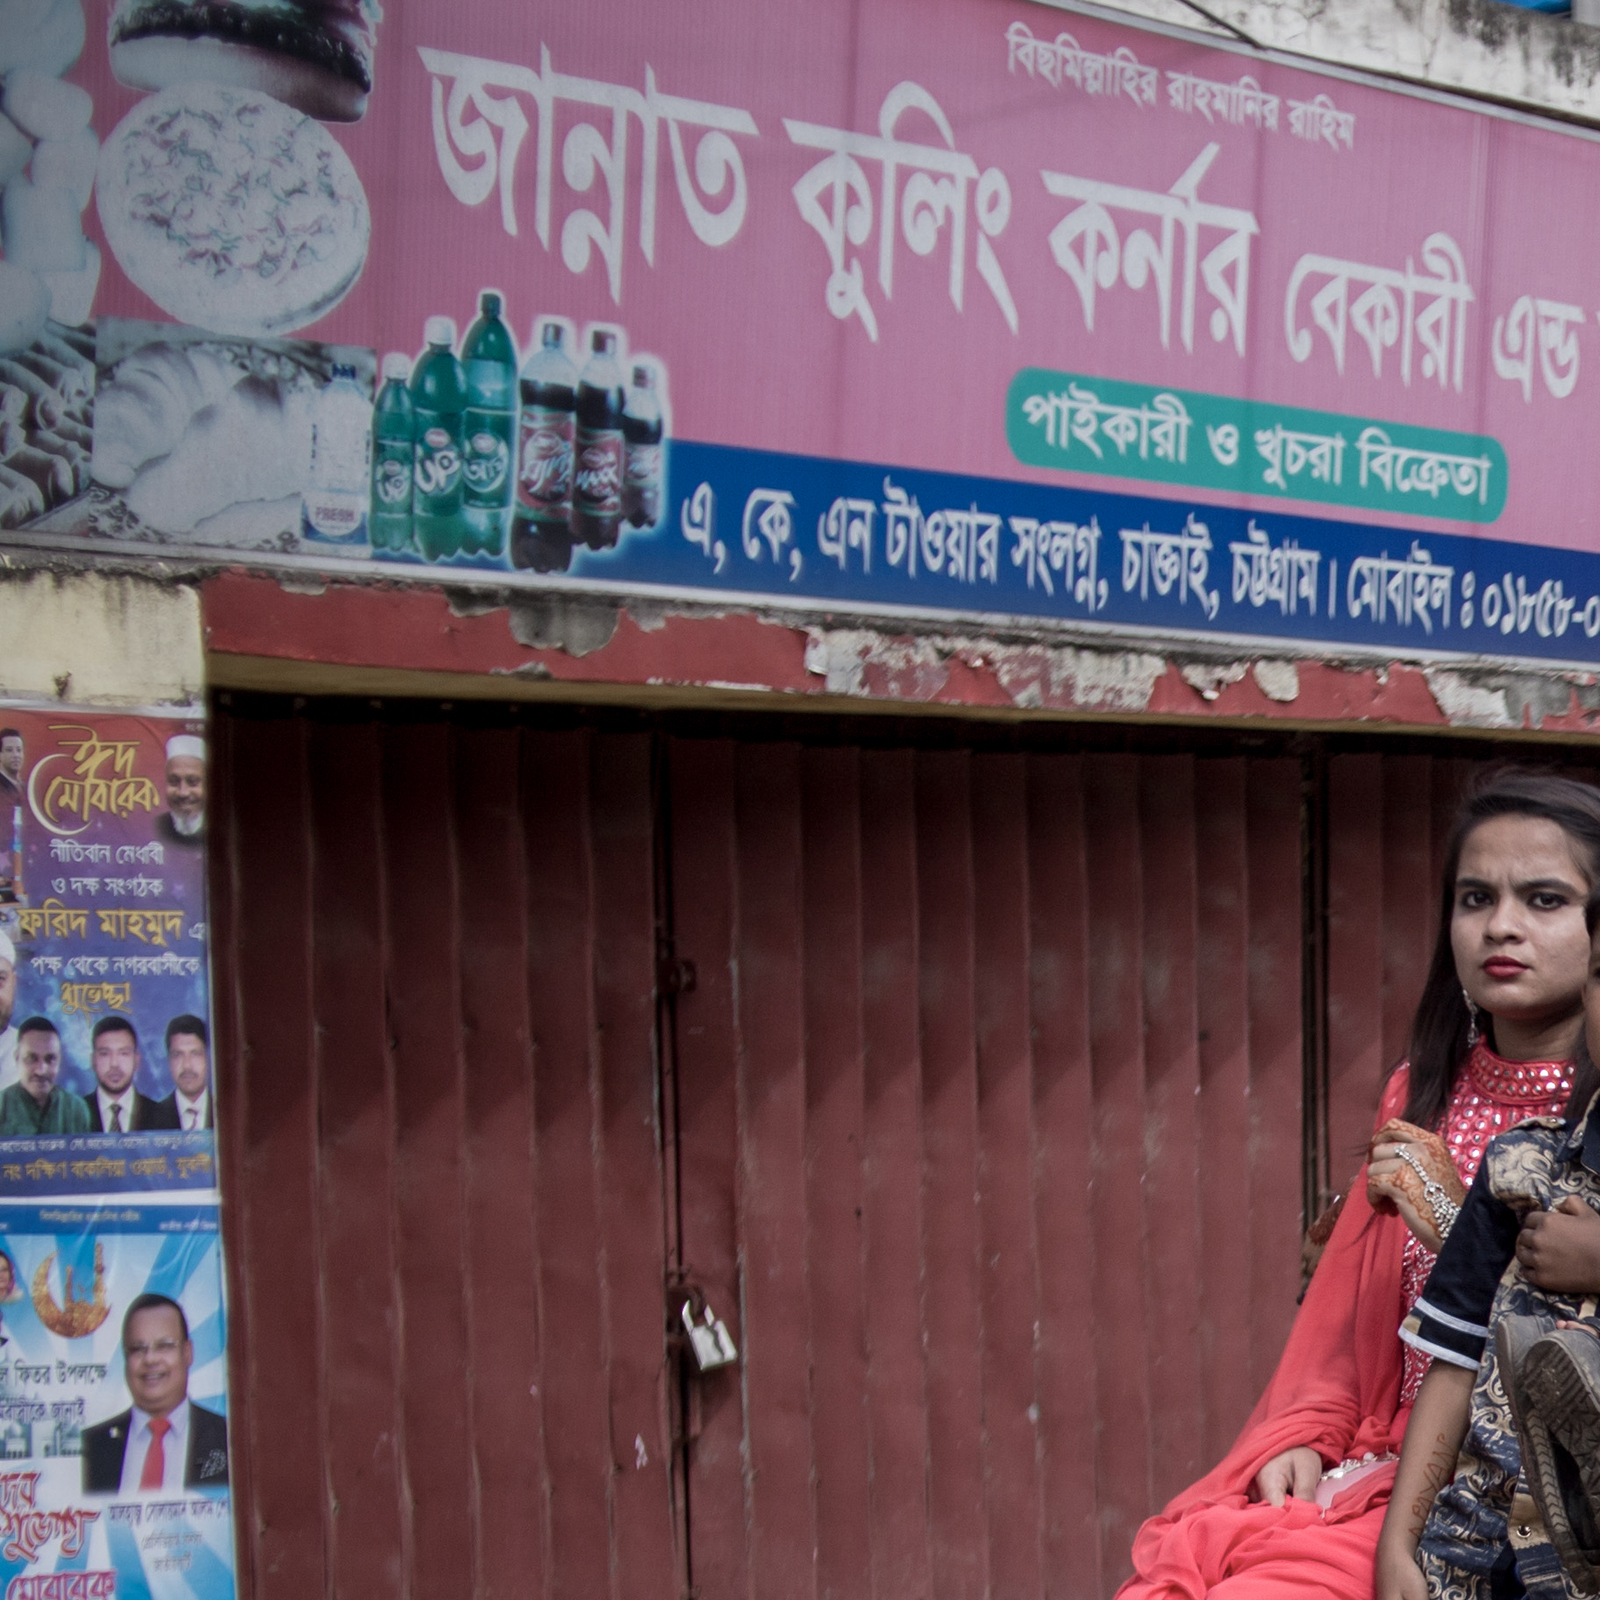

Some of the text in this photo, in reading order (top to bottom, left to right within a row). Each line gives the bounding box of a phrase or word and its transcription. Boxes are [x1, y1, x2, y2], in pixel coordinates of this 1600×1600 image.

[416, 41, 760, 306] জান্নাত
[782, 81, 1019, 343] কুলিং
[1285, 232, 1475, 394] বেকারী
[1023, 383, 1491, 505] পাইকারী ও খুচরা বিক্রেতা
[818, 496, 876, 575] এন
[47, 724, 140, 779] ঈদ
[44, 775, 160, 822] মোবারক
[50, 838, 164, 865] নীতিবান মেধাবী
[51, 873, 164, 897] ও দক্ষ সংগঠক
[16, 898, 89, 938] ফরিদ
[96, 906, 185, 947] মাহমুদ
[31, 956, 61, 976] পক্ষ
[67, 956, 109, 976] থেকে
